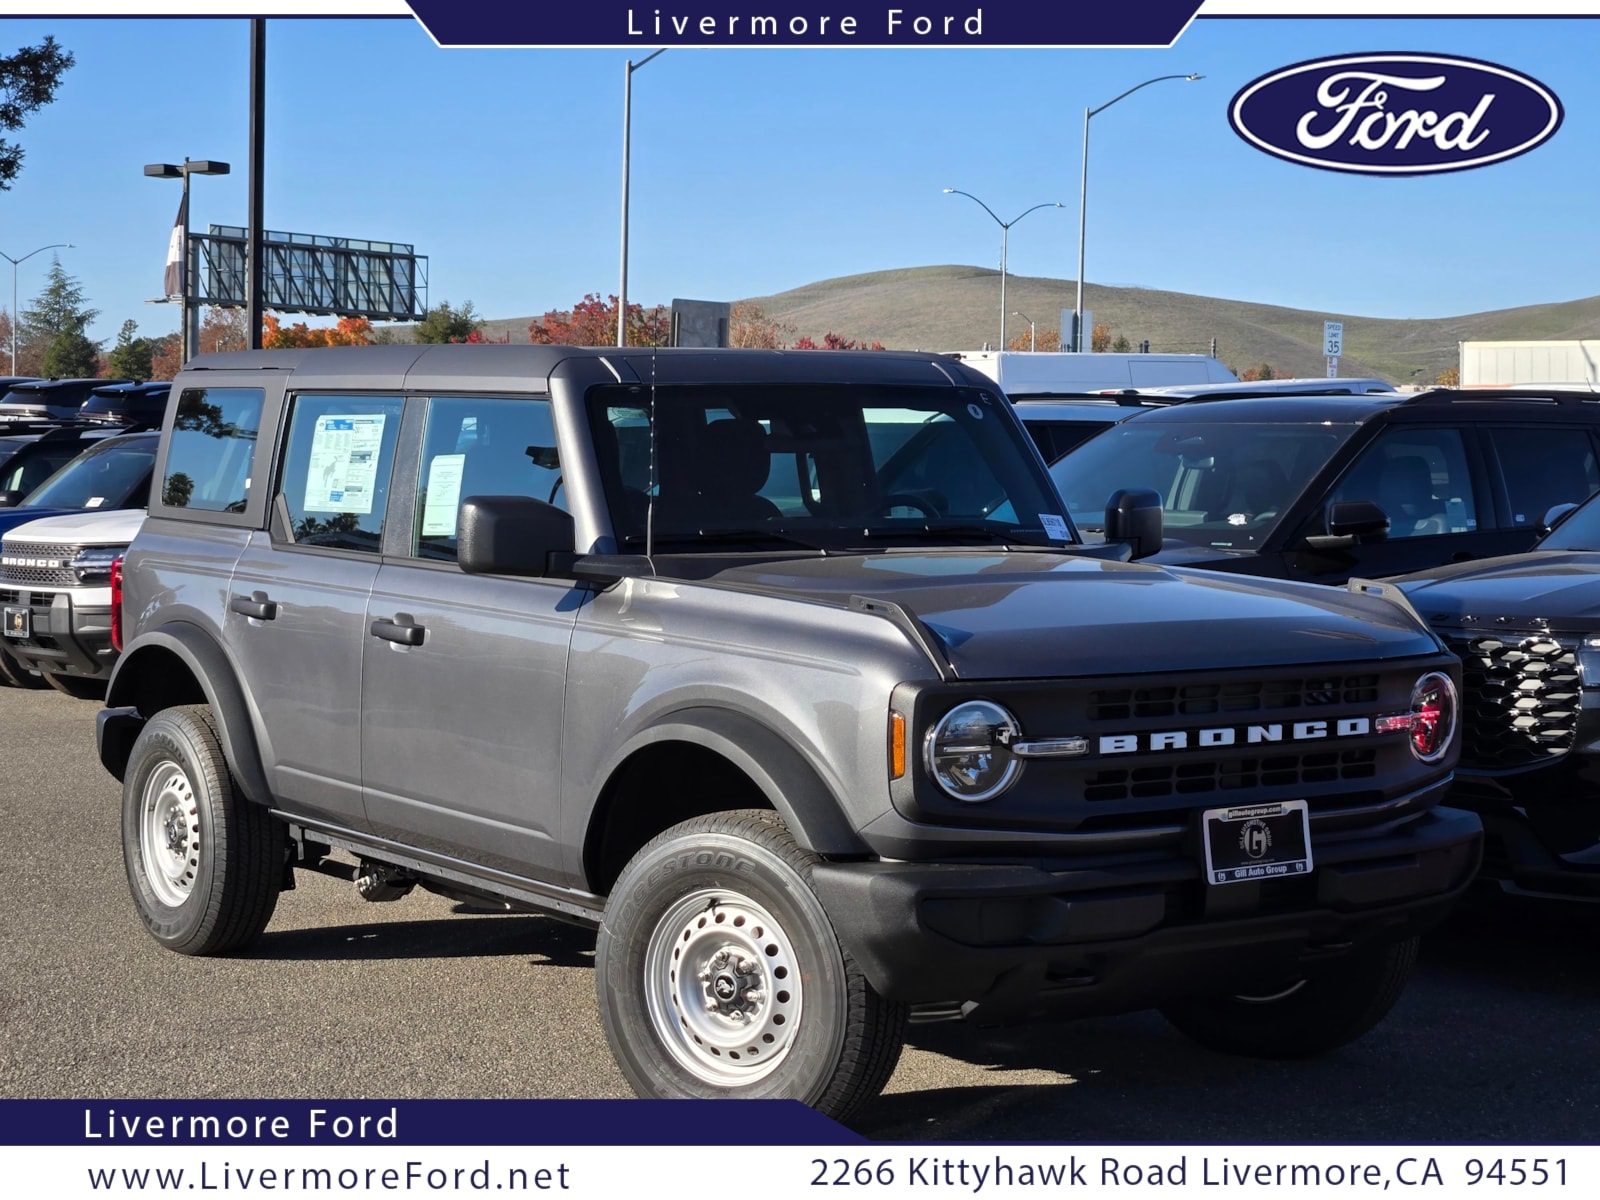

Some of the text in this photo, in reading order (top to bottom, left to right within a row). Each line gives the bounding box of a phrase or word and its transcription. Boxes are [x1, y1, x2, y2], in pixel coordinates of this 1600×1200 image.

[1327, 340, 1340, 354] 35
[2, 557, 59, 568] BRONCO
[1100, 717, 1370, 754] BRONCO
[1228, 806, 1282, 819] gillautogroup.com
[1234, 868, 1247, 879] Gill
[1248, 867, 1265, 877] Auto
[1265, 864, 1288, 875] Group
